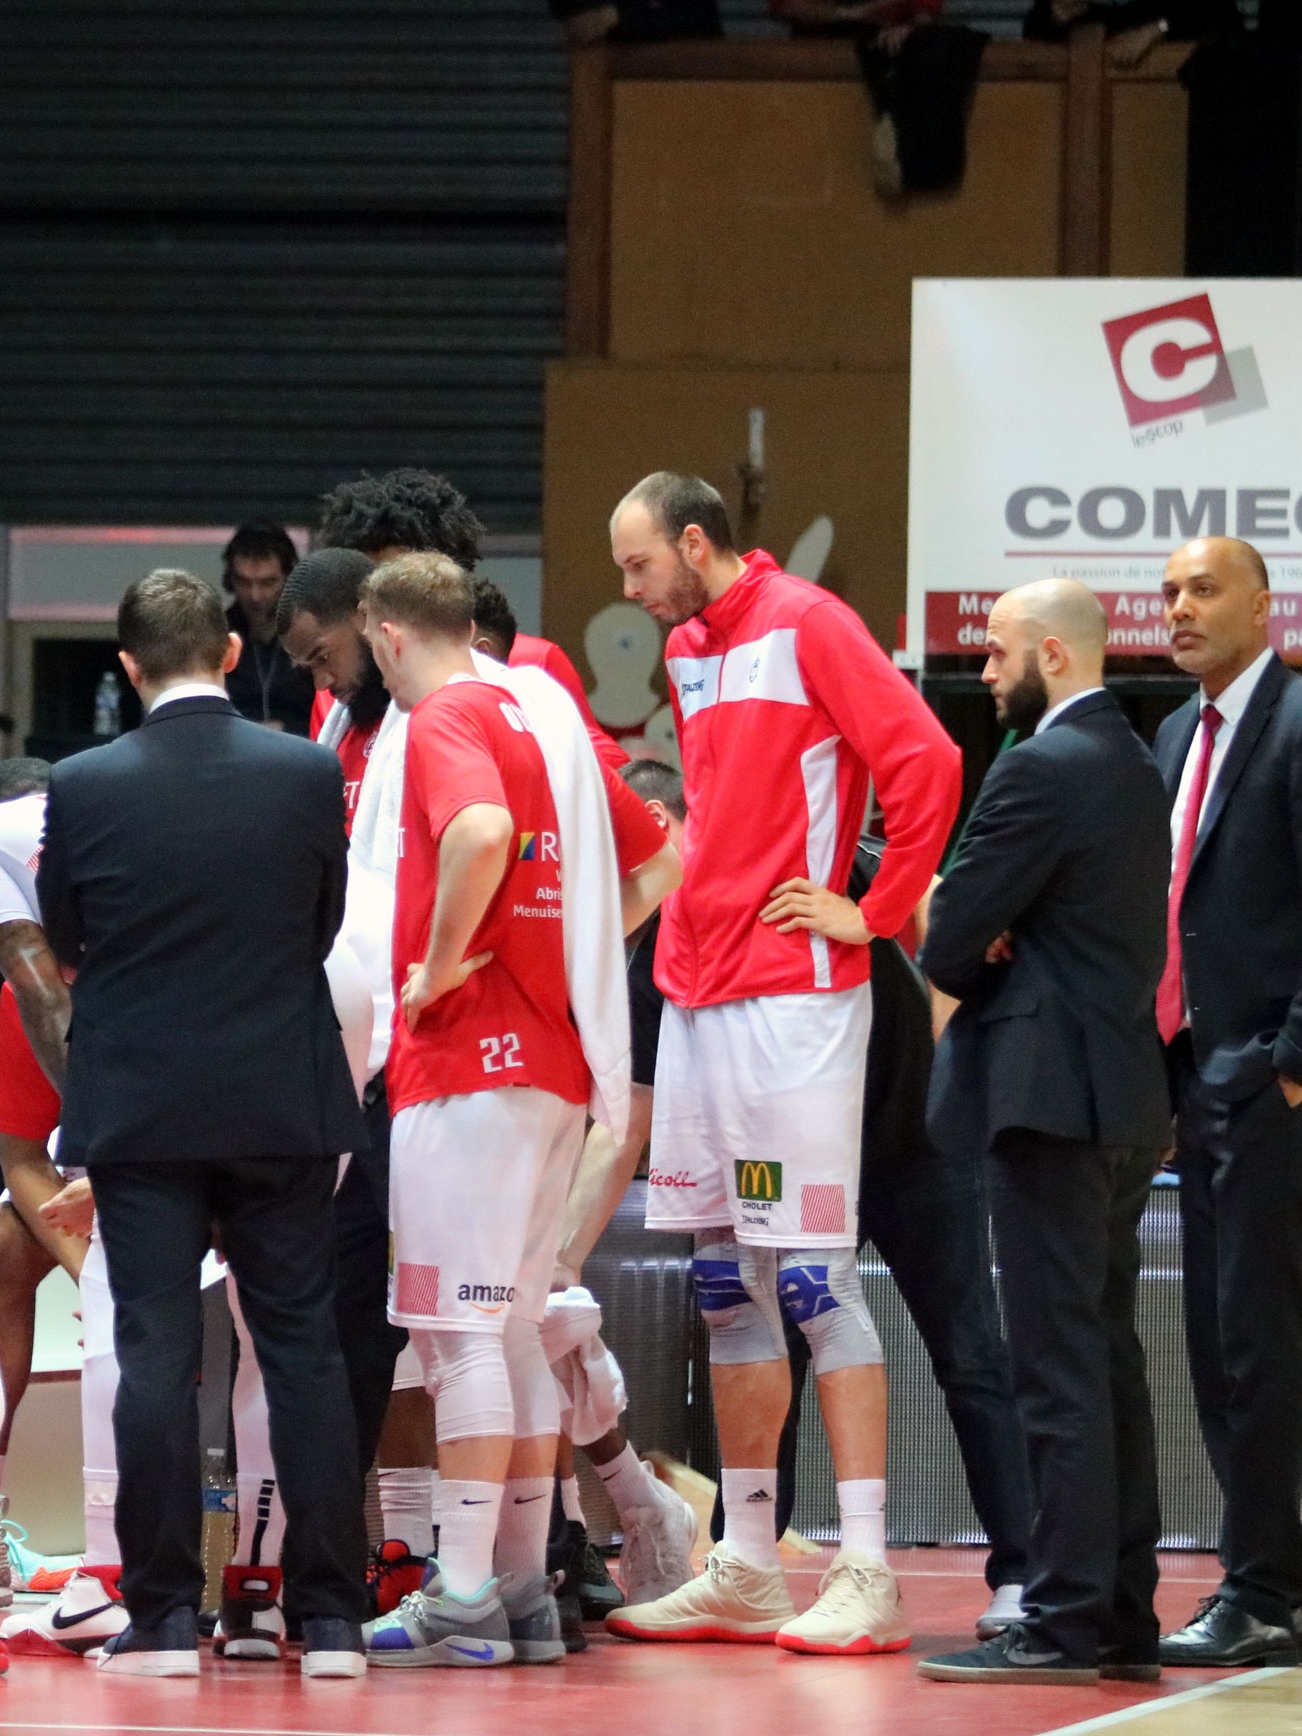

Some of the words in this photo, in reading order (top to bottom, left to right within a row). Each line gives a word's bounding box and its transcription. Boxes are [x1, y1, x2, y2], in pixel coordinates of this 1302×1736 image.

[1004, 486, 1302, 541] COME
[541, 831, 561, 862] R
[479, 1032, 523, 1073] 22
[649, 1168, 698, 1188] icoll
[741, 1201, 773, 1210] CHOLET
